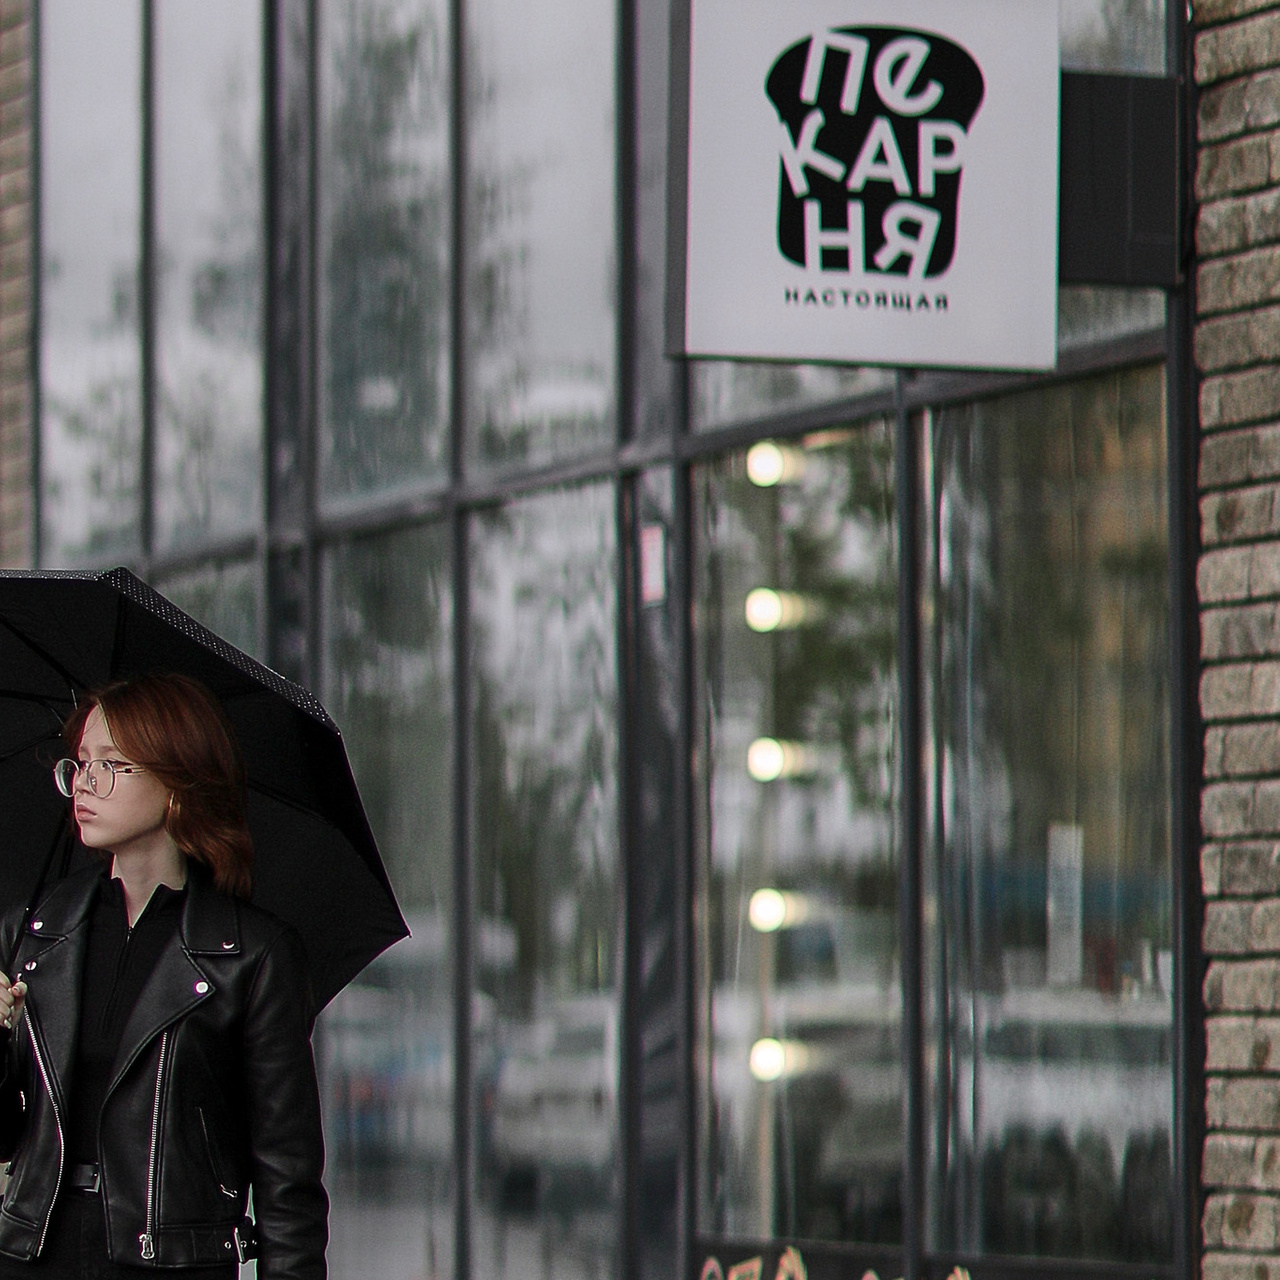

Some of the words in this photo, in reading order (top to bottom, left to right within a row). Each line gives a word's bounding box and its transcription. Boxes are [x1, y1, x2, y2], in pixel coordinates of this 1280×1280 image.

[778, 109, 967, 198] КАР
[804, 199, 941, 278] НЯ
[784, 287, 950, 312] НАСТОЯЩАЯ
